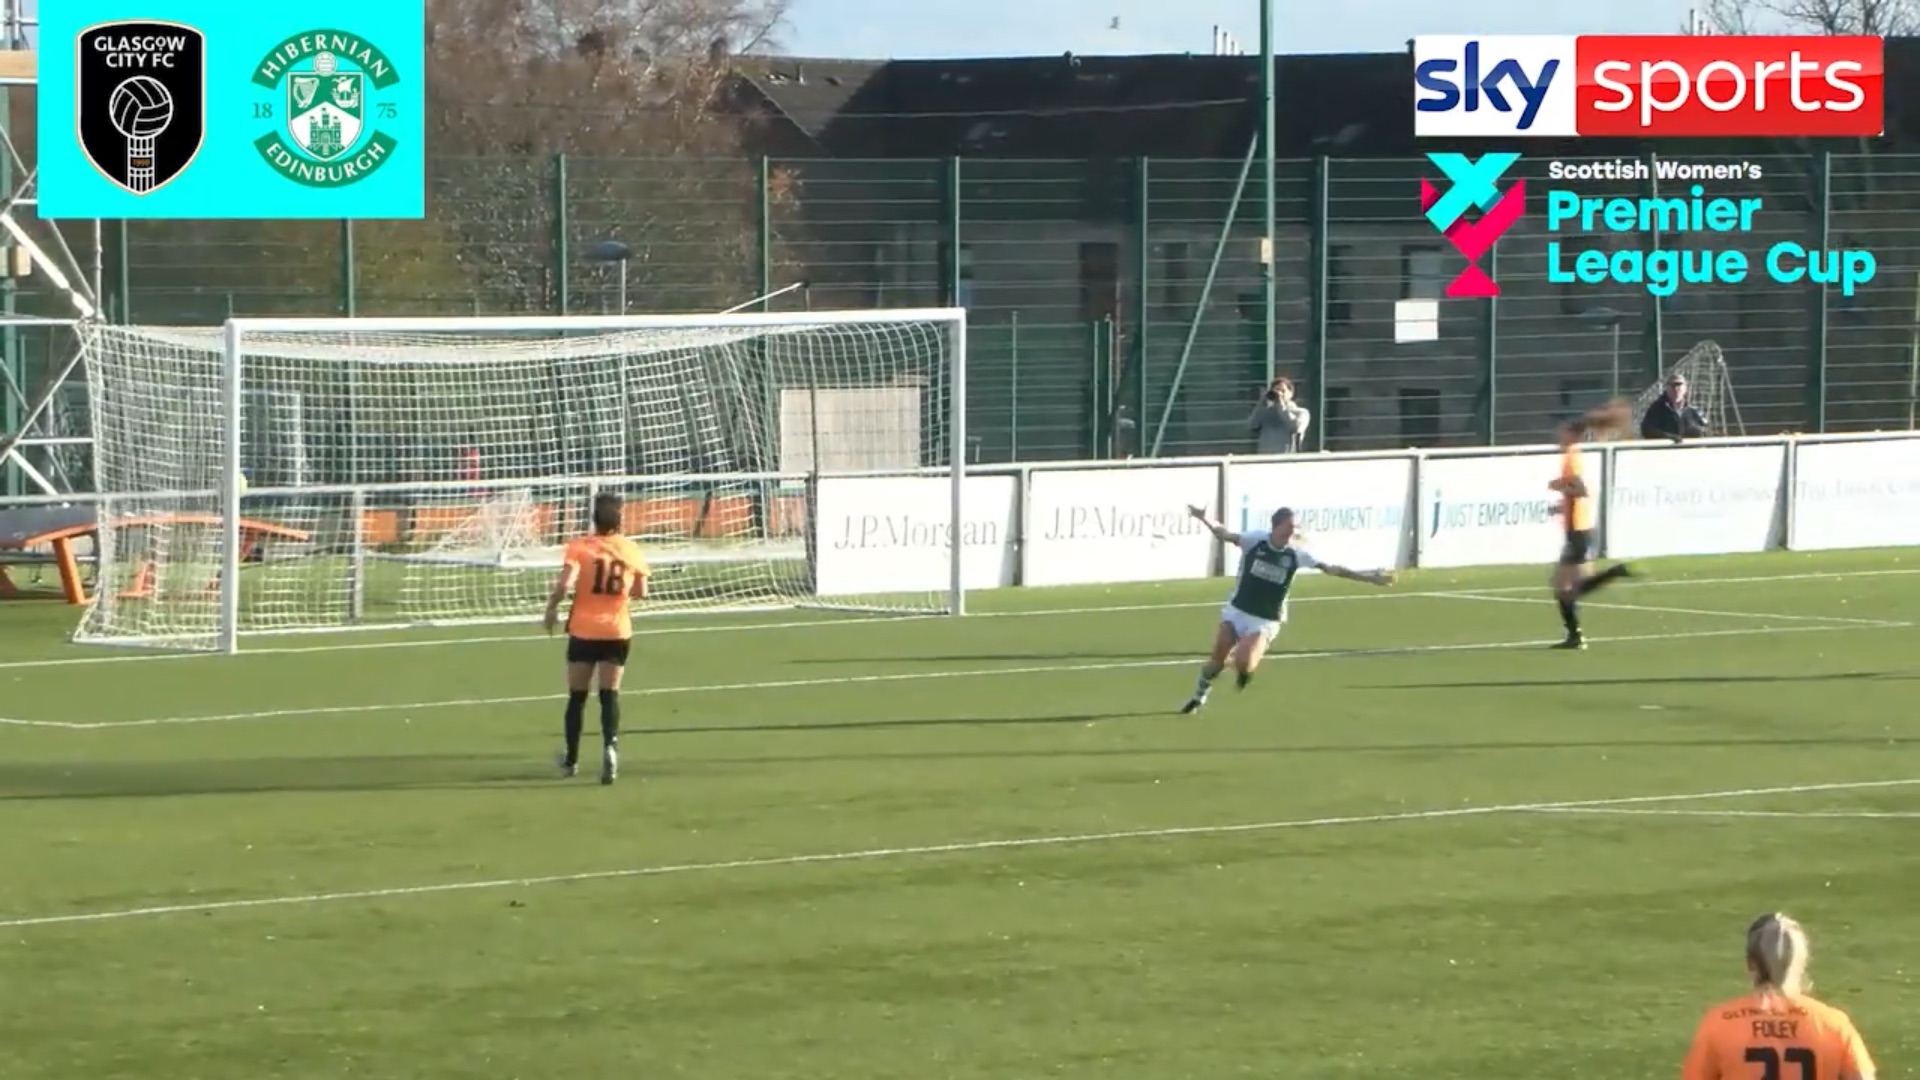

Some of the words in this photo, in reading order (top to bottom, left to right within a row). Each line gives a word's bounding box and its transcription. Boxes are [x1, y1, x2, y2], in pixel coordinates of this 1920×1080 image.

[1287, 503, 1373, 532] MPLOYMENT
[1478, 499, 1549, 526] EMPLOYME
[593, 558, 625, 595] 18
[1752, 1020, 1798, 1038] FOLEY
